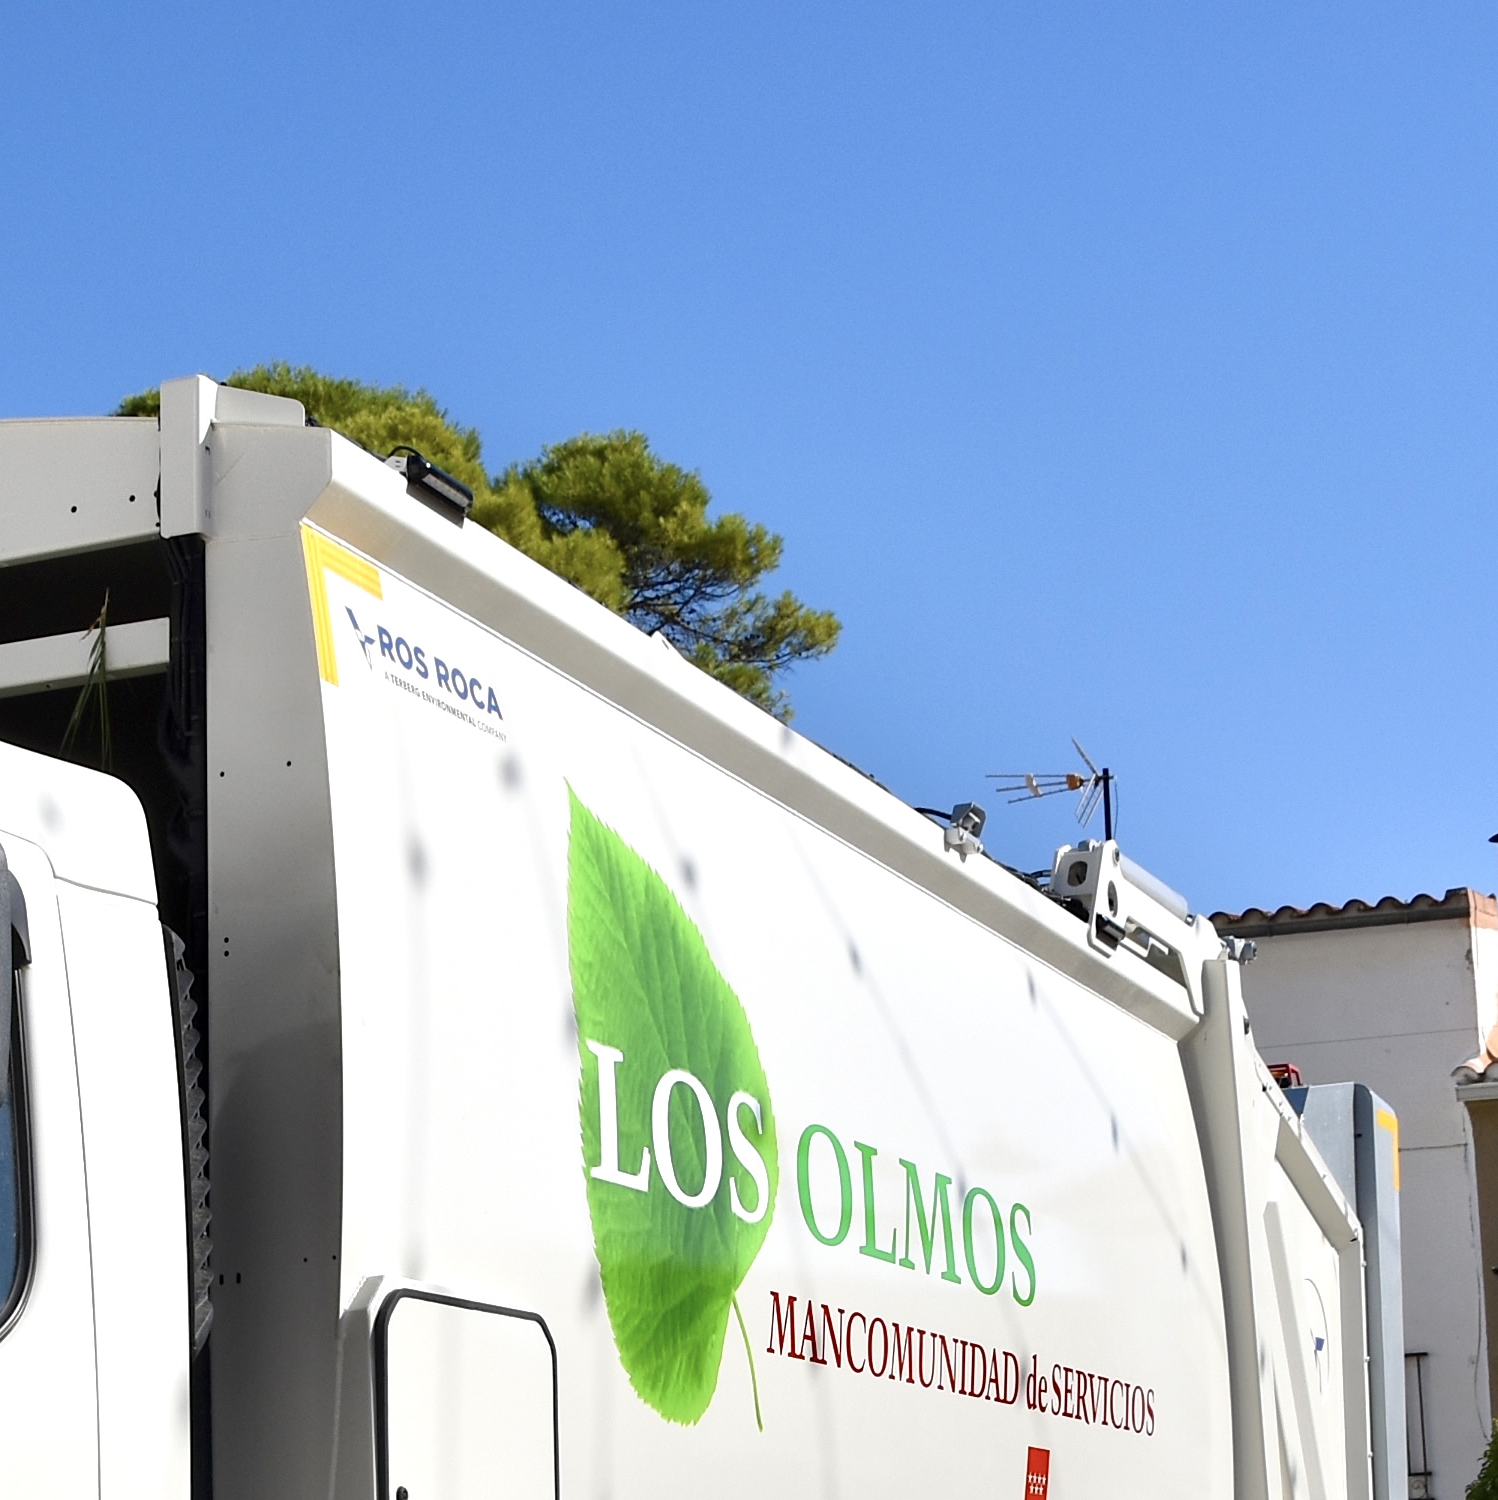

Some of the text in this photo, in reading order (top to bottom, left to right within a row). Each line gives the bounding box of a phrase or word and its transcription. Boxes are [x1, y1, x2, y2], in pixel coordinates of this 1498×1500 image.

[377, 624, 503, 721] ROS ROCA
[390, 673, 421, 698] TERBERG
[421, 690, 476, 728] ENVIRONMENTAL
[477, 720, 507, 743] COMPANY
[585, 1038, 1037, 1307] LOS OLMOS
[766, 1290, 1019, 1406] MANCOMUNIDAD
[1050, 1363, 1155, 1437] SERVICIOS
